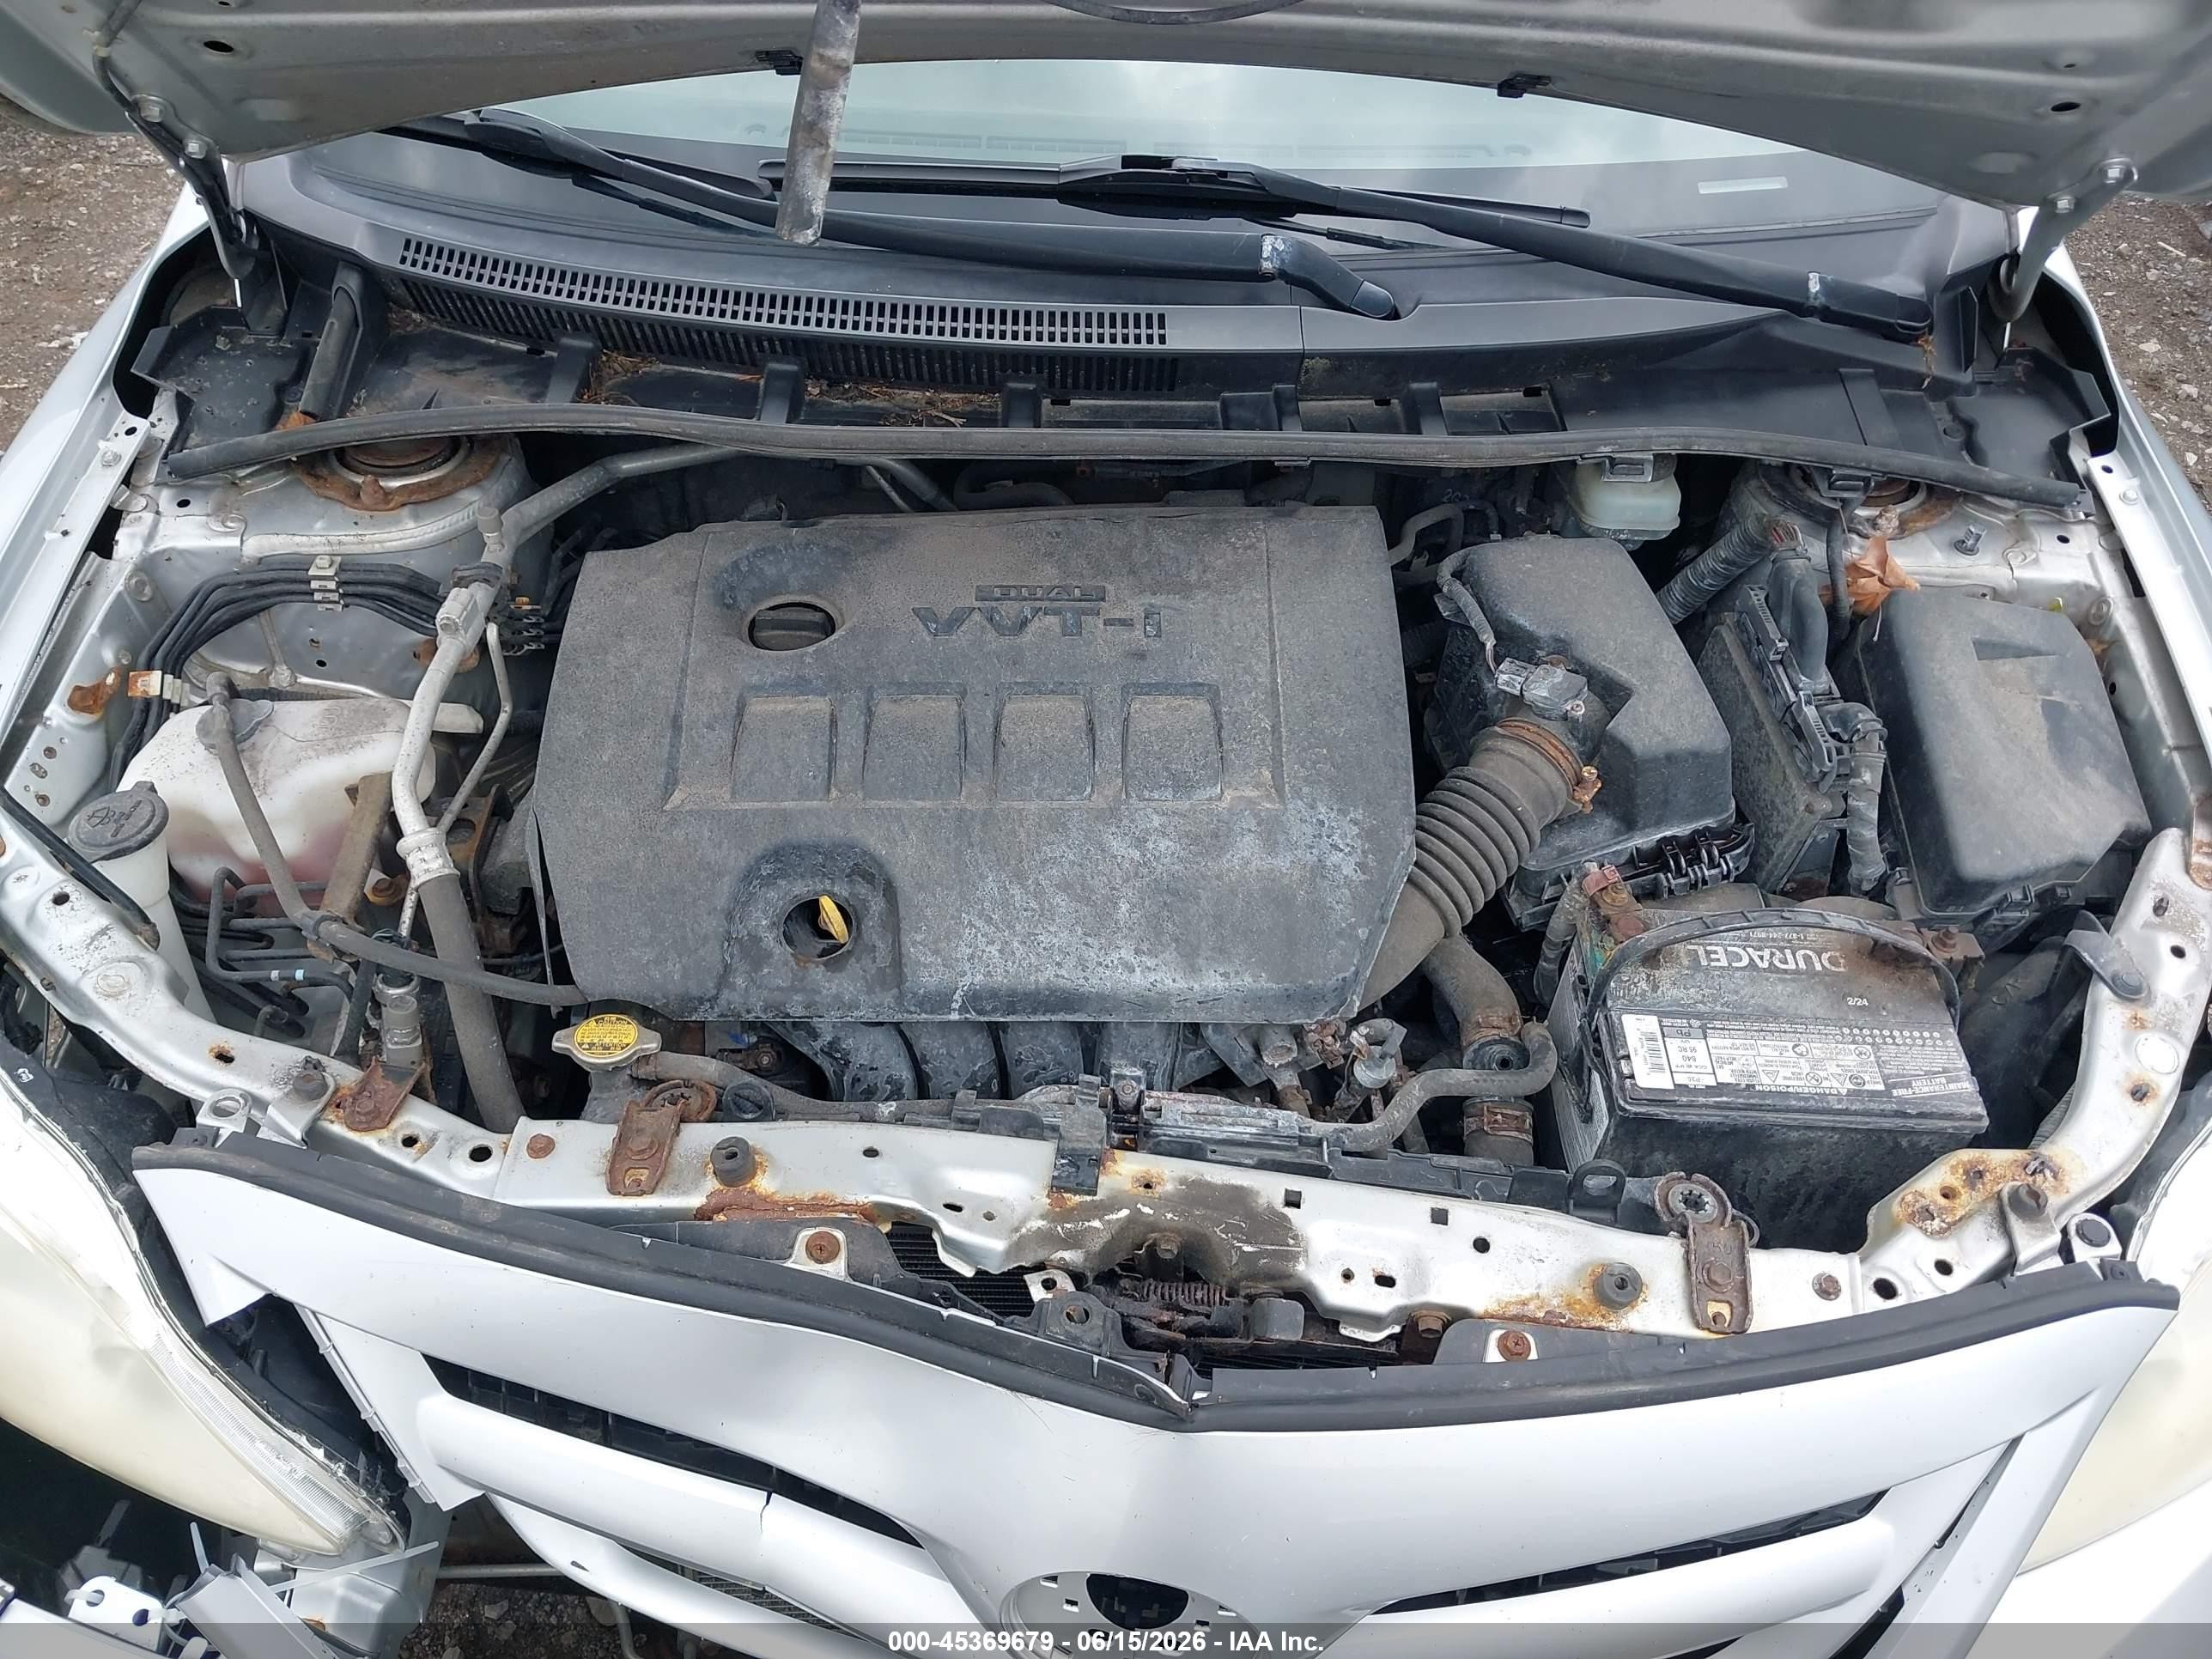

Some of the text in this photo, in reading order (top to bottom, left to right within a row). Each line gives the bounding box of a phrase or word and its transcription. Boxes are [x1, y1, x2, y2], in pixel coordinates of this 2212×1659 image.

[994, 586, 1096, 598] DUAL
[1847, 997, 1869, 1006] 2/24
[1676, 1029, 1691, 1037] Pb
[1911, 1077, 1948, 1087] BATTERY
[1755, 1084, 1838, 1094] DANGER/POISON
[1892, 1081, 1971, 1097] MAINTENANCE-FREE
